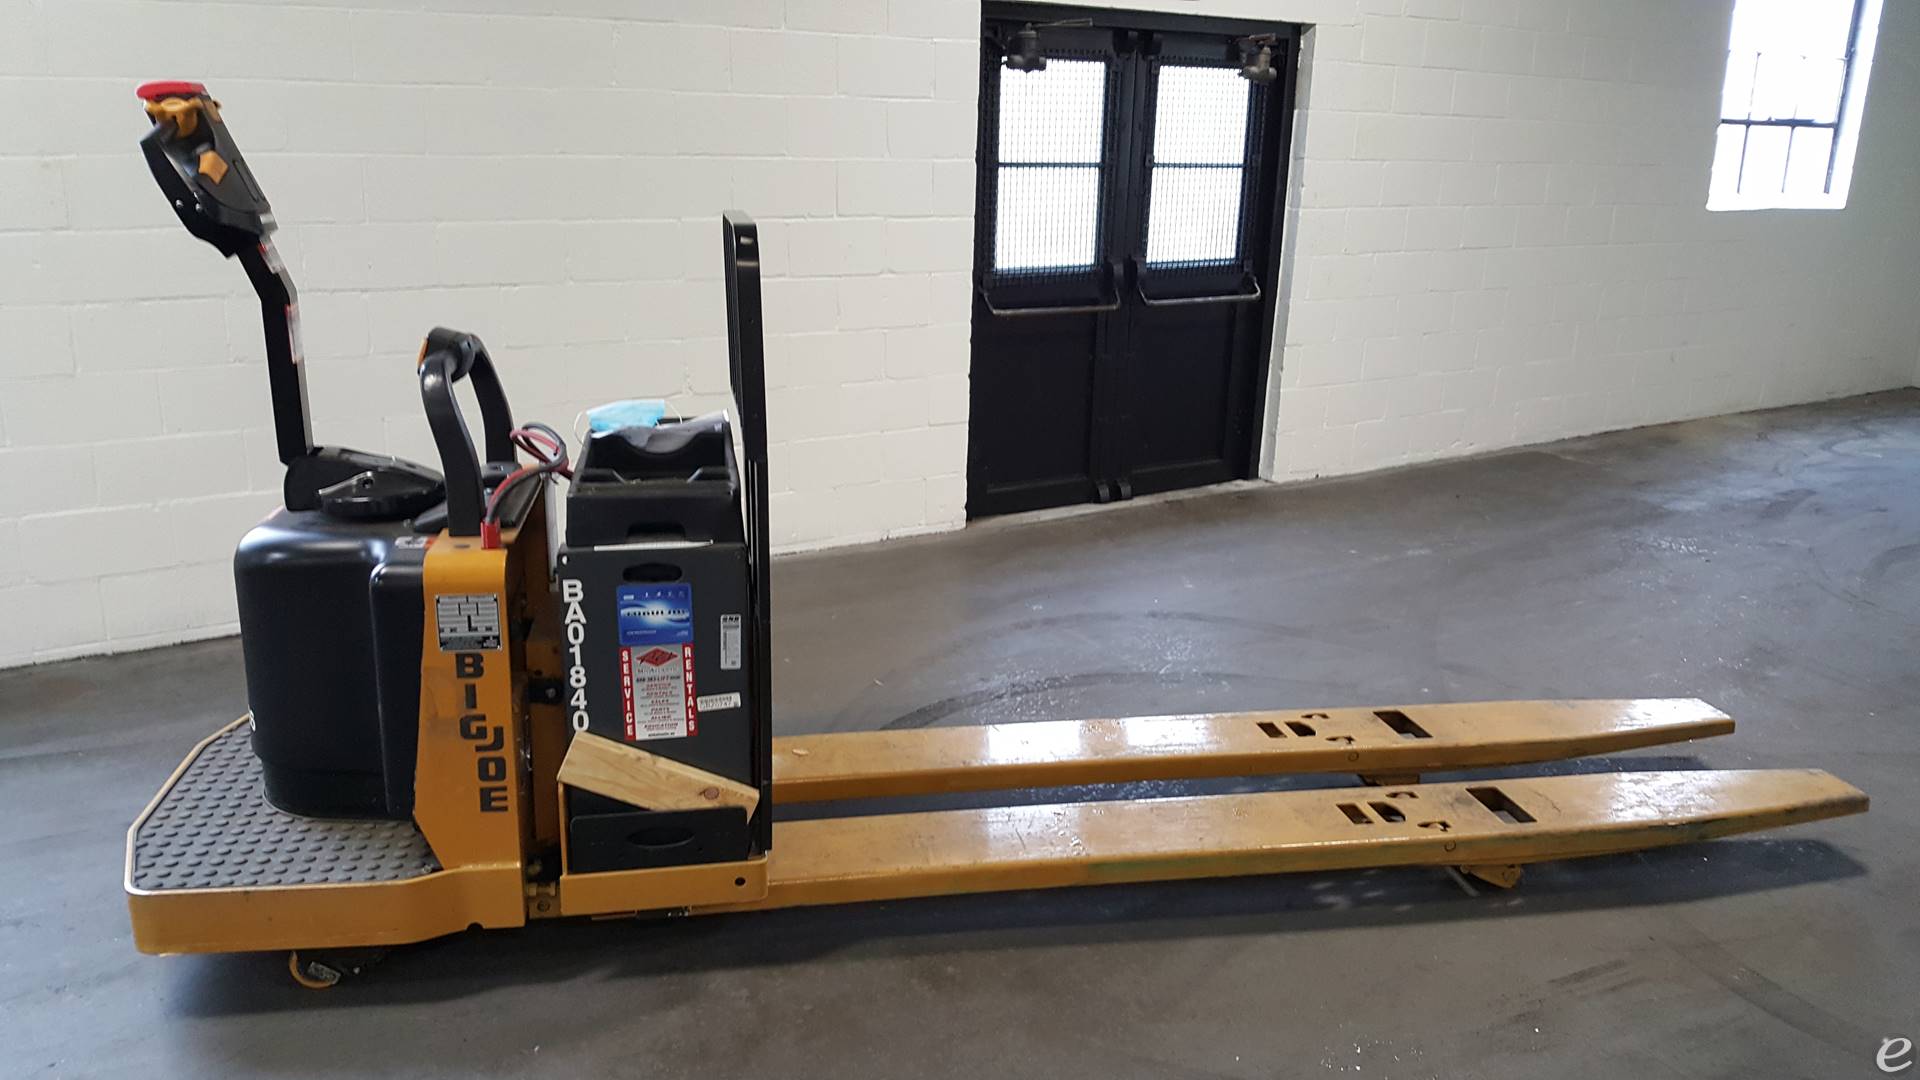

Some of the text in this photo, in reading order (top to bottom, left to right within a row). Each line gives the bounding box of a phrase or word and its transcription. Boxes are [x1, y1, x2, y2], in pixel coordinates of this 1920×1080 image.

[562, 579, 590, 732] BA01840
[622, 650, 633, 736] SERVICE
[684, 646, 695, 731] RENTALS
[456, 653, 488, 740] BIG
[475, 726, 509, 812] JOE
